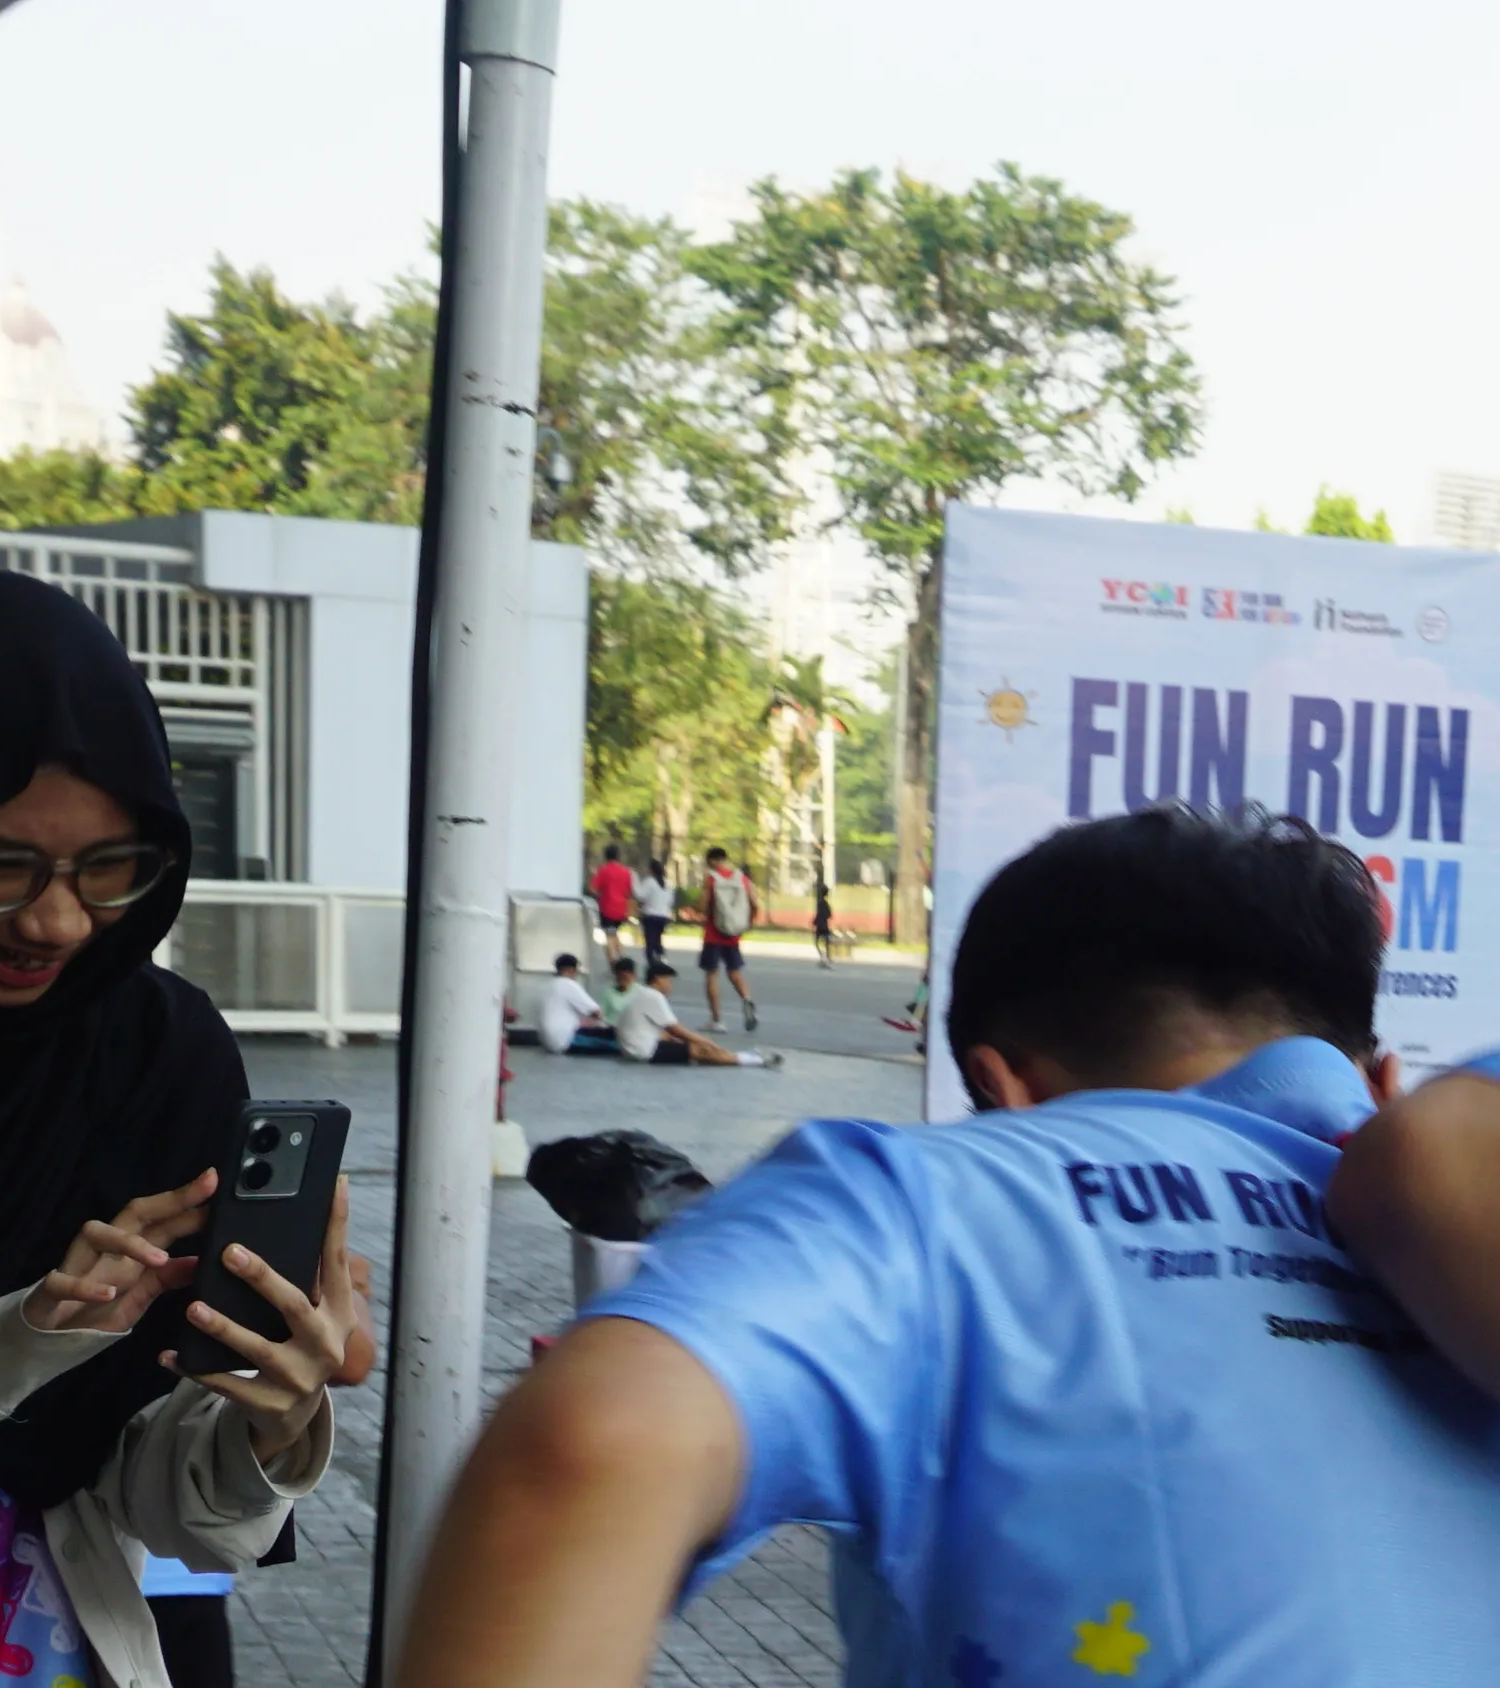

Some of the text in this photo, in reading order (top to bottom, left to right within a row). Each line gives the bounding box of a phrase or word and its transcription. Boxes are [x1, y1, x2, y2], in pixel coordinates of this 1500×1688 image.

[1100, 578, 1188, 607] YCI
[1067, 676, 1469, 843] FUN RUN
[1064, 1160, 1334, 1242] FUN RU
